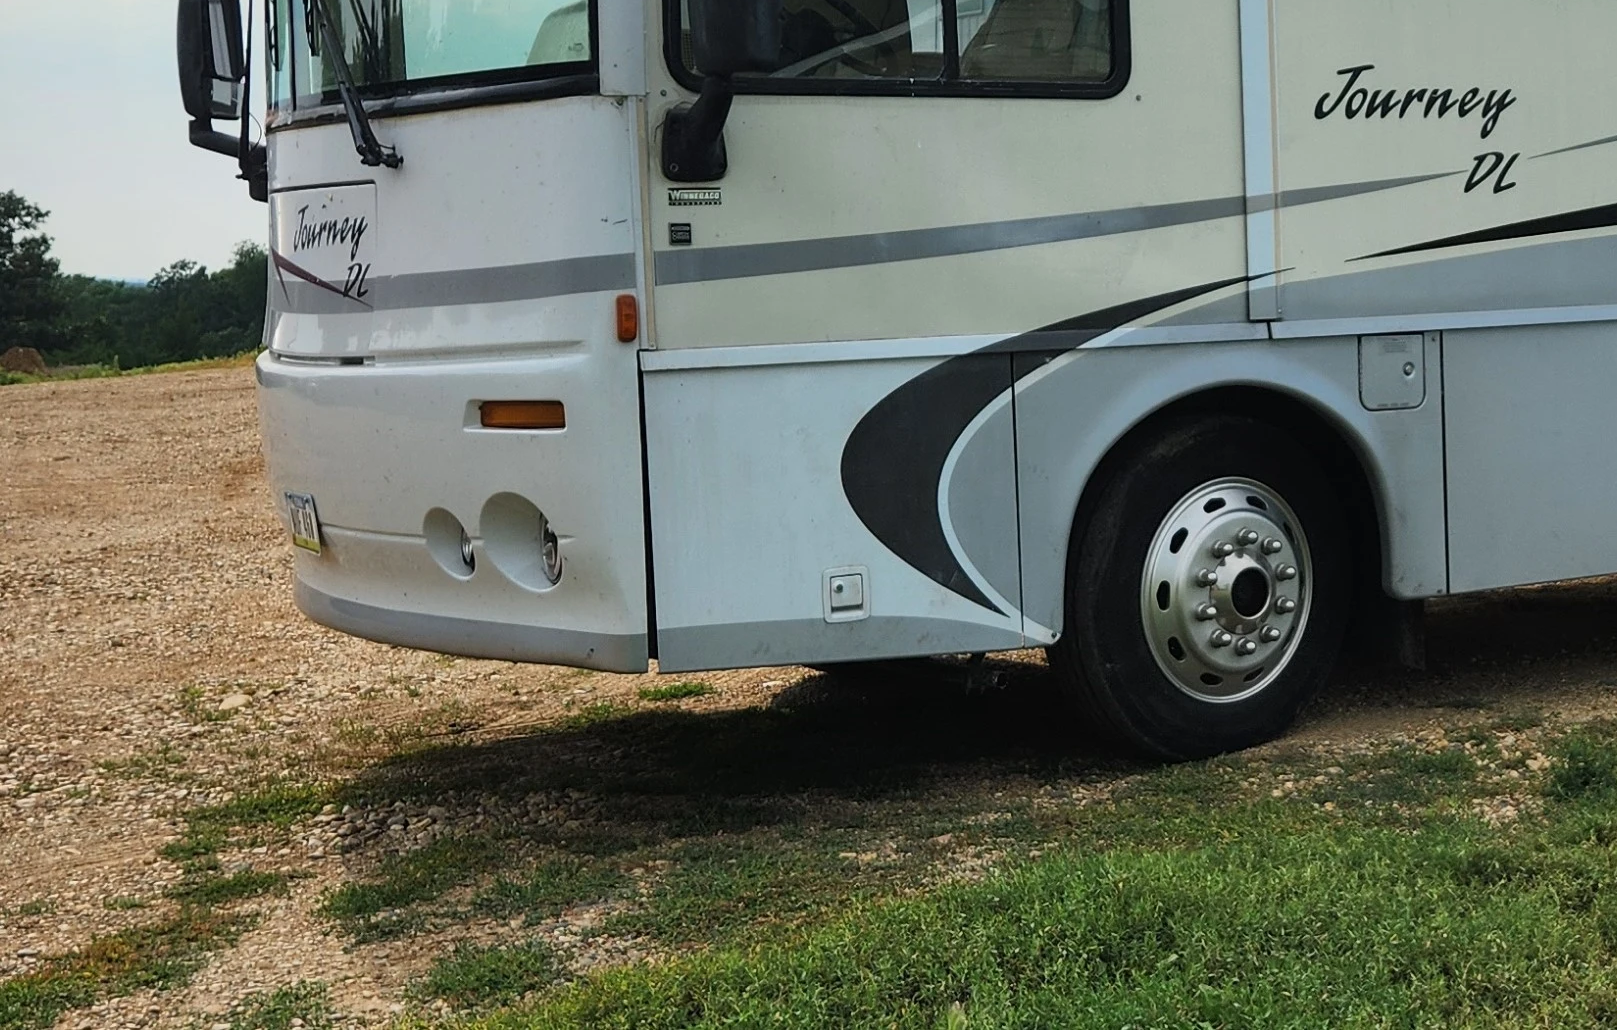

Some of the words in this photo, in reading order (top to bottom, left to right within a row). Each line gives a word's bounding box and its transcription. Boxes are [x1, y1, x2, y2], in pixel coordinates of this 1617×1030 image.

[1313, 64, 1518, 140] Journey
[1463, 151, 1521, 194] DL
[293, 204, 369, 262] Journey
[343, 262, 371, 298] DL
